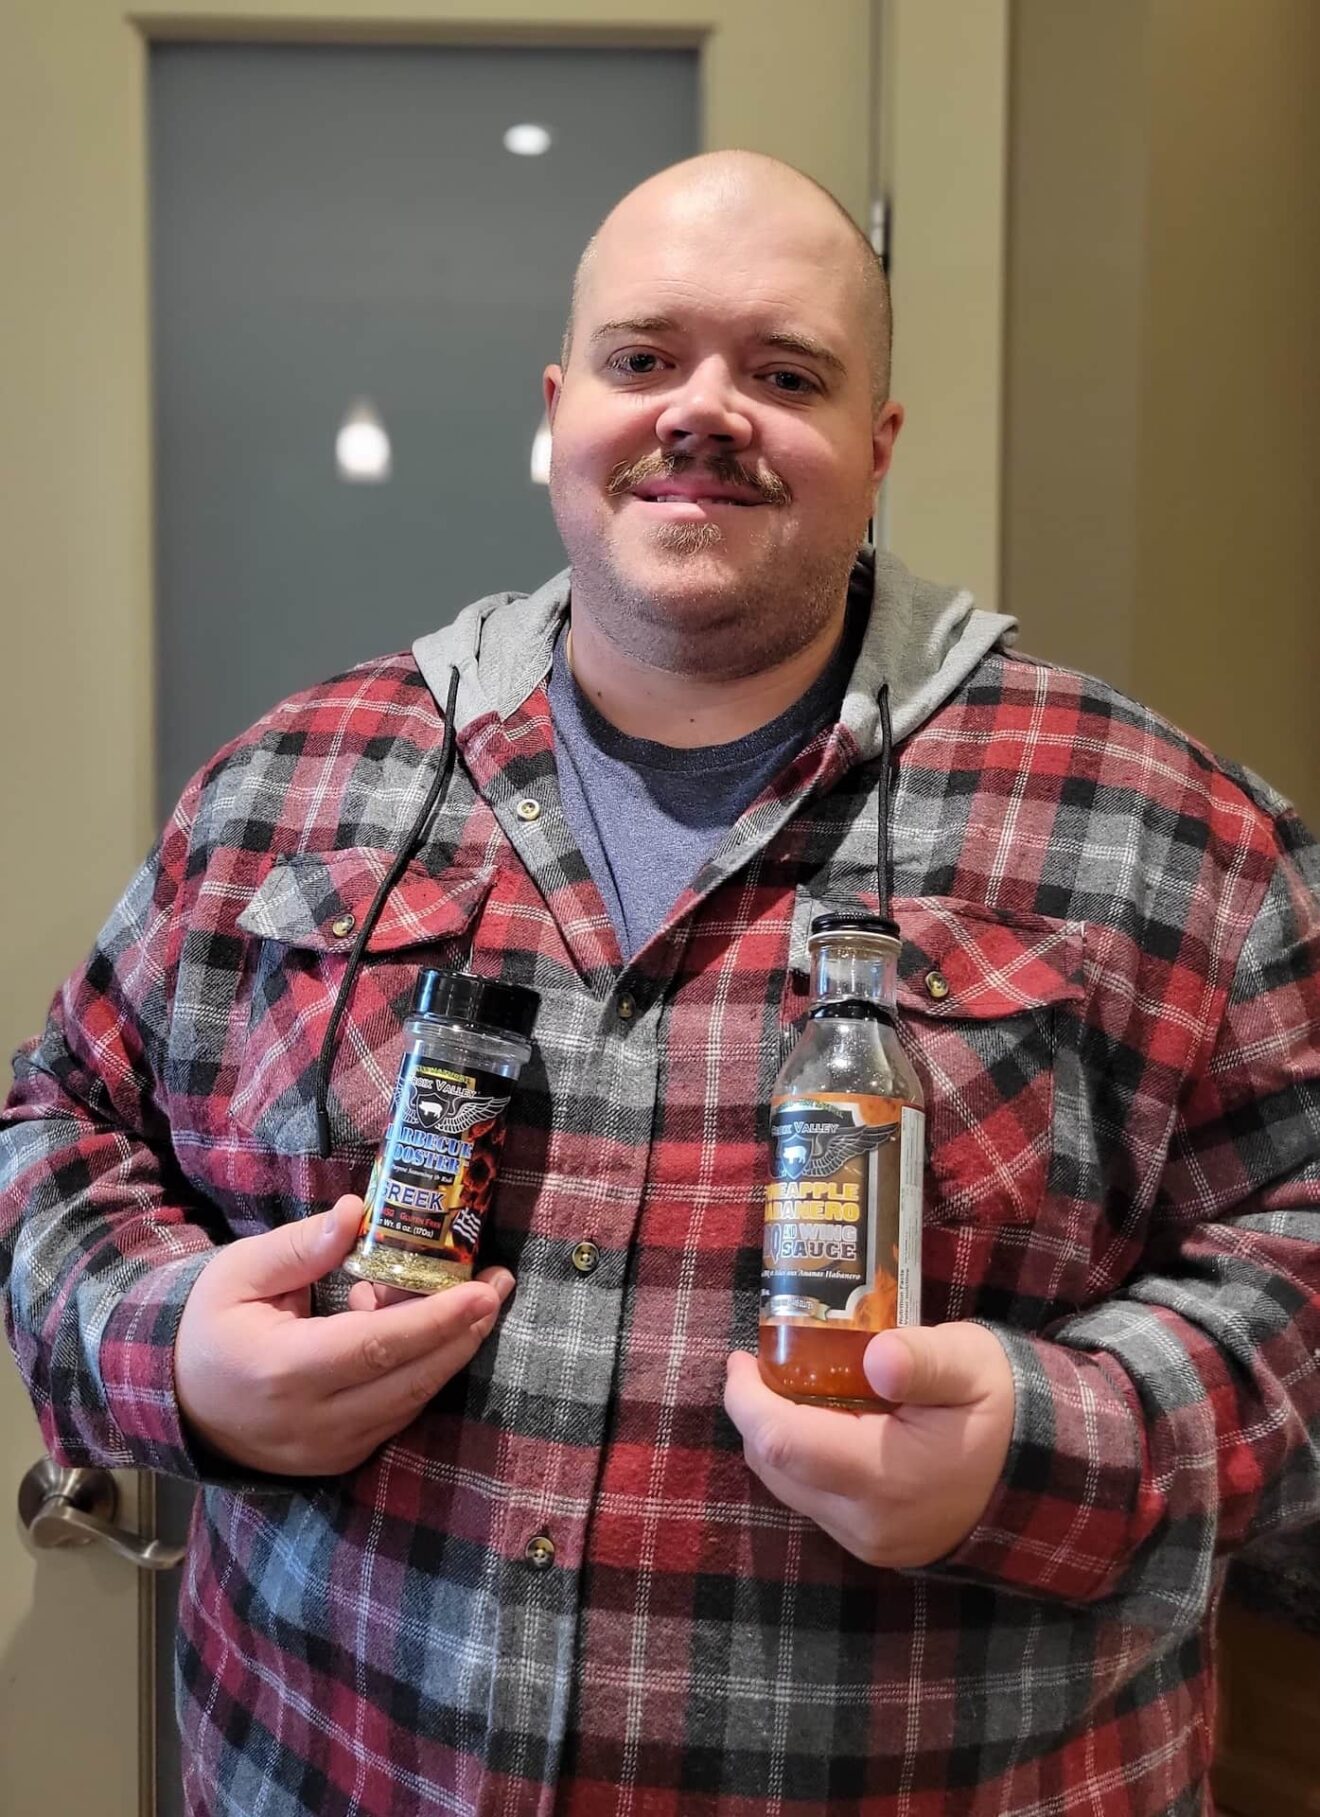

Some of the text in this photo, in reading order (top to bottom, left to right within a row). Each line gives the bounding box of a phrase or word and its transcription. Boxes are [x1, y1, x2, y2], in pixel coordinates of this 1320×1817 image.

[435, 1079, 478, 1099] VALLEY
[793, 1121, 840, 1135] VALLEY
[782, 1223, 798, 1240] AND
[798, 1223, 858, 1242] WING
[780, 1240, 857, 1262] SAUCE
